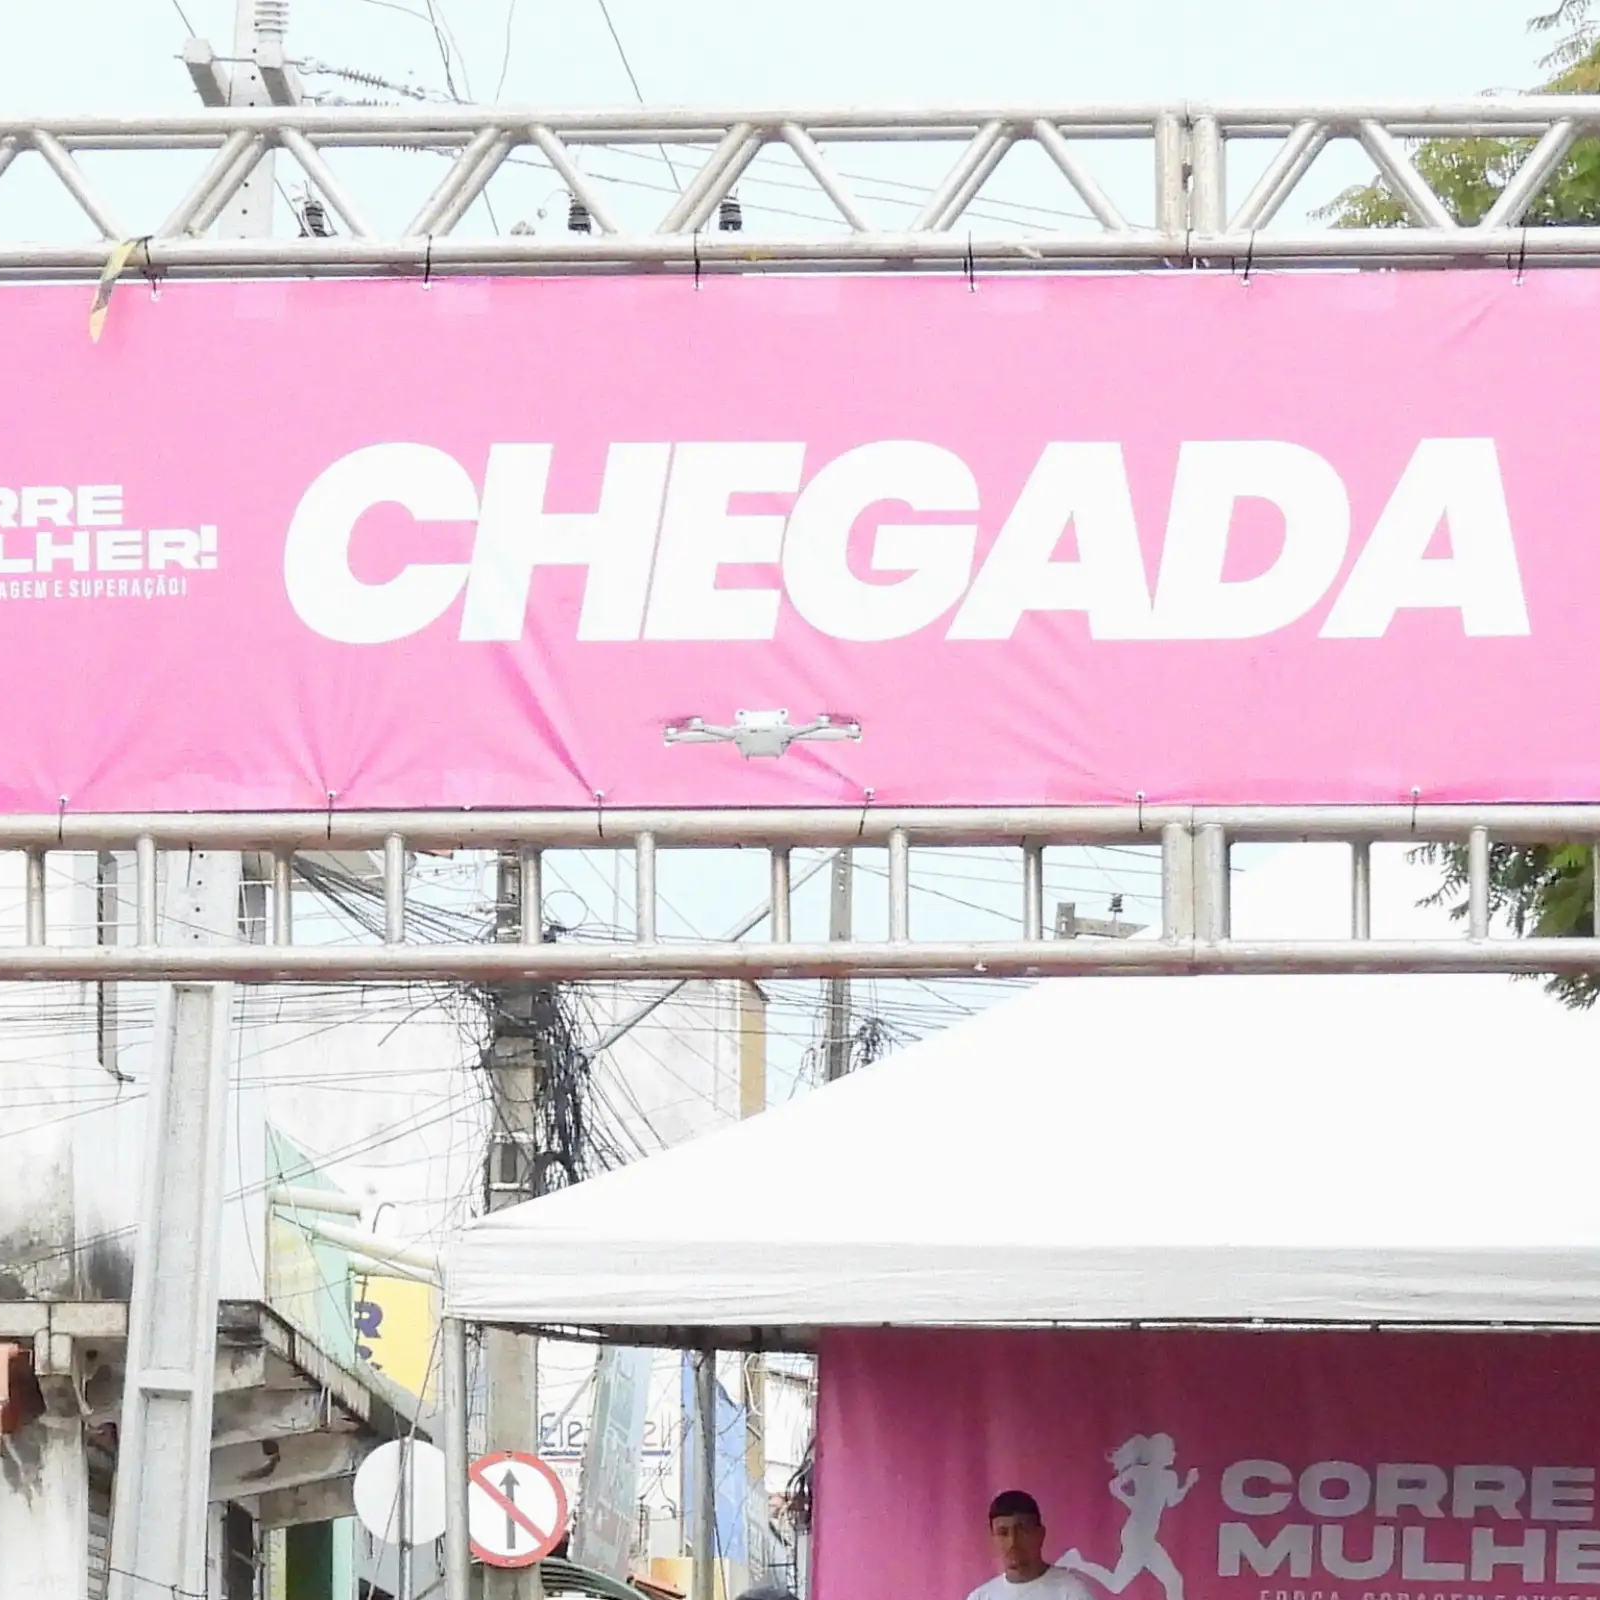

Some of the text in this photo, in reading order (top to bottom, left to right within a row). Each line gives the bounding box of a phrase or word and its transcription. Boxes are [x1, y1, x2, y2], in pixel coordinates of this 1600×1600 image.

[284, 438, 1531, 643] CHEGADA
[55, 580, 63, 598] E
[68, 573, 188, 598] SUPERAÇÃO!
[1220, 1459, 1596, 1522] CORRE
